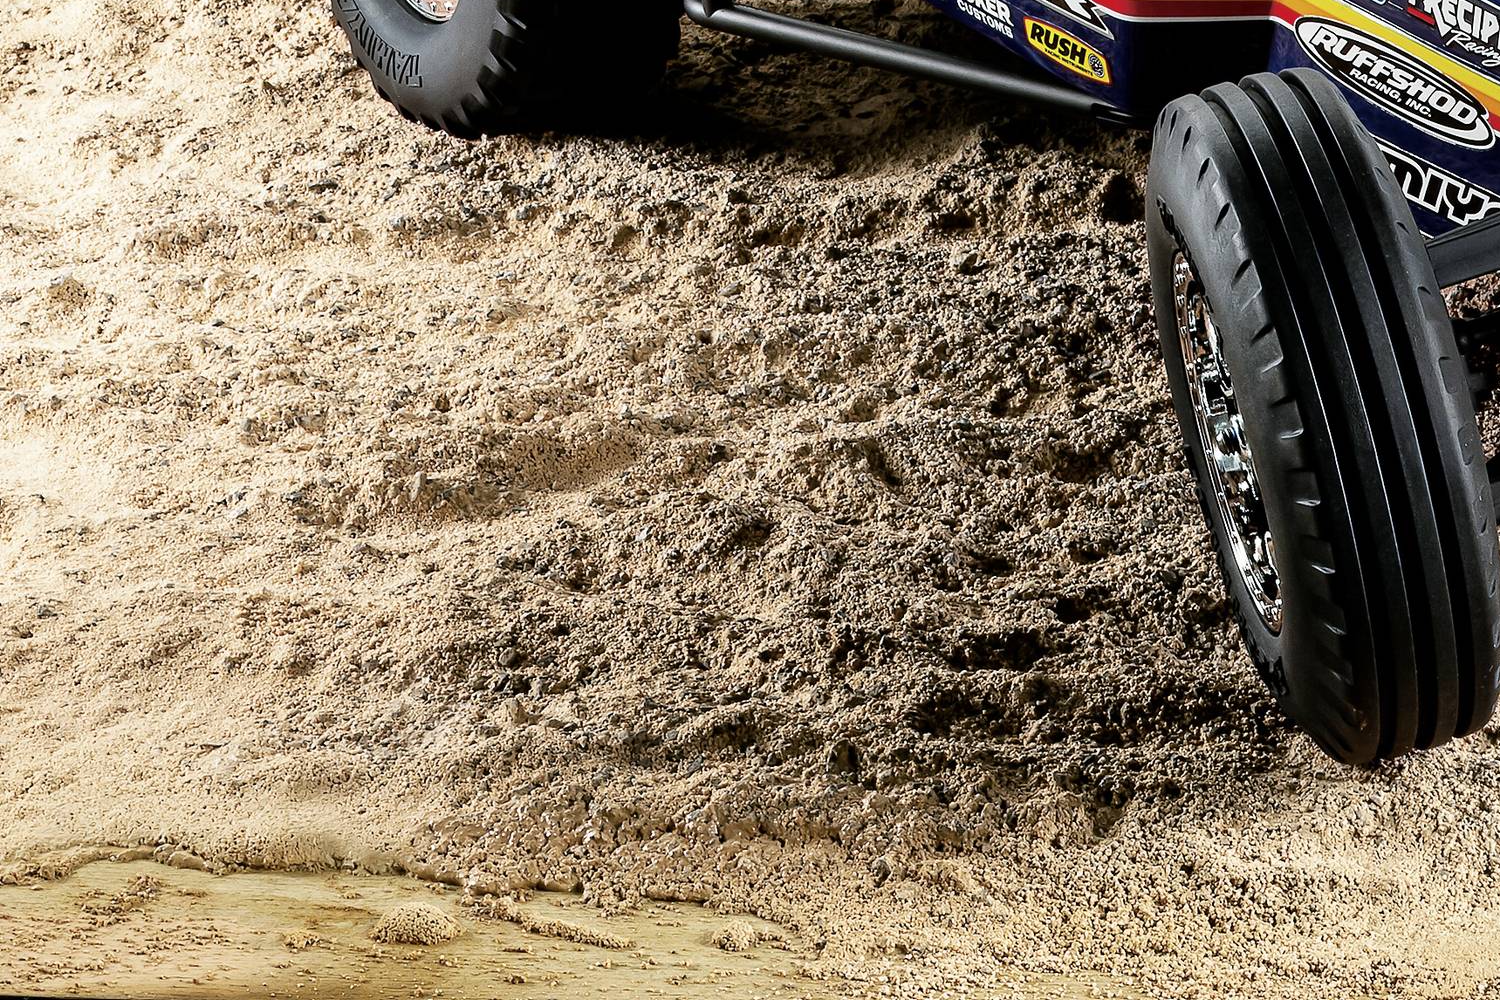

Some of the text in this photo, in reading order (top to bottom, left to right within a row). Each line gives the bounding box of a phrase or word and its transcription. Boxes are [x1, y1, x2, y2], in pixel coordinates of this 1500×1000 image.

[1030, 22, 1088, 66] RUSH
[1309, 26, 1479, 125] RUFFSHOD
[1349, 69, 1432, 118] RACING, INC.
